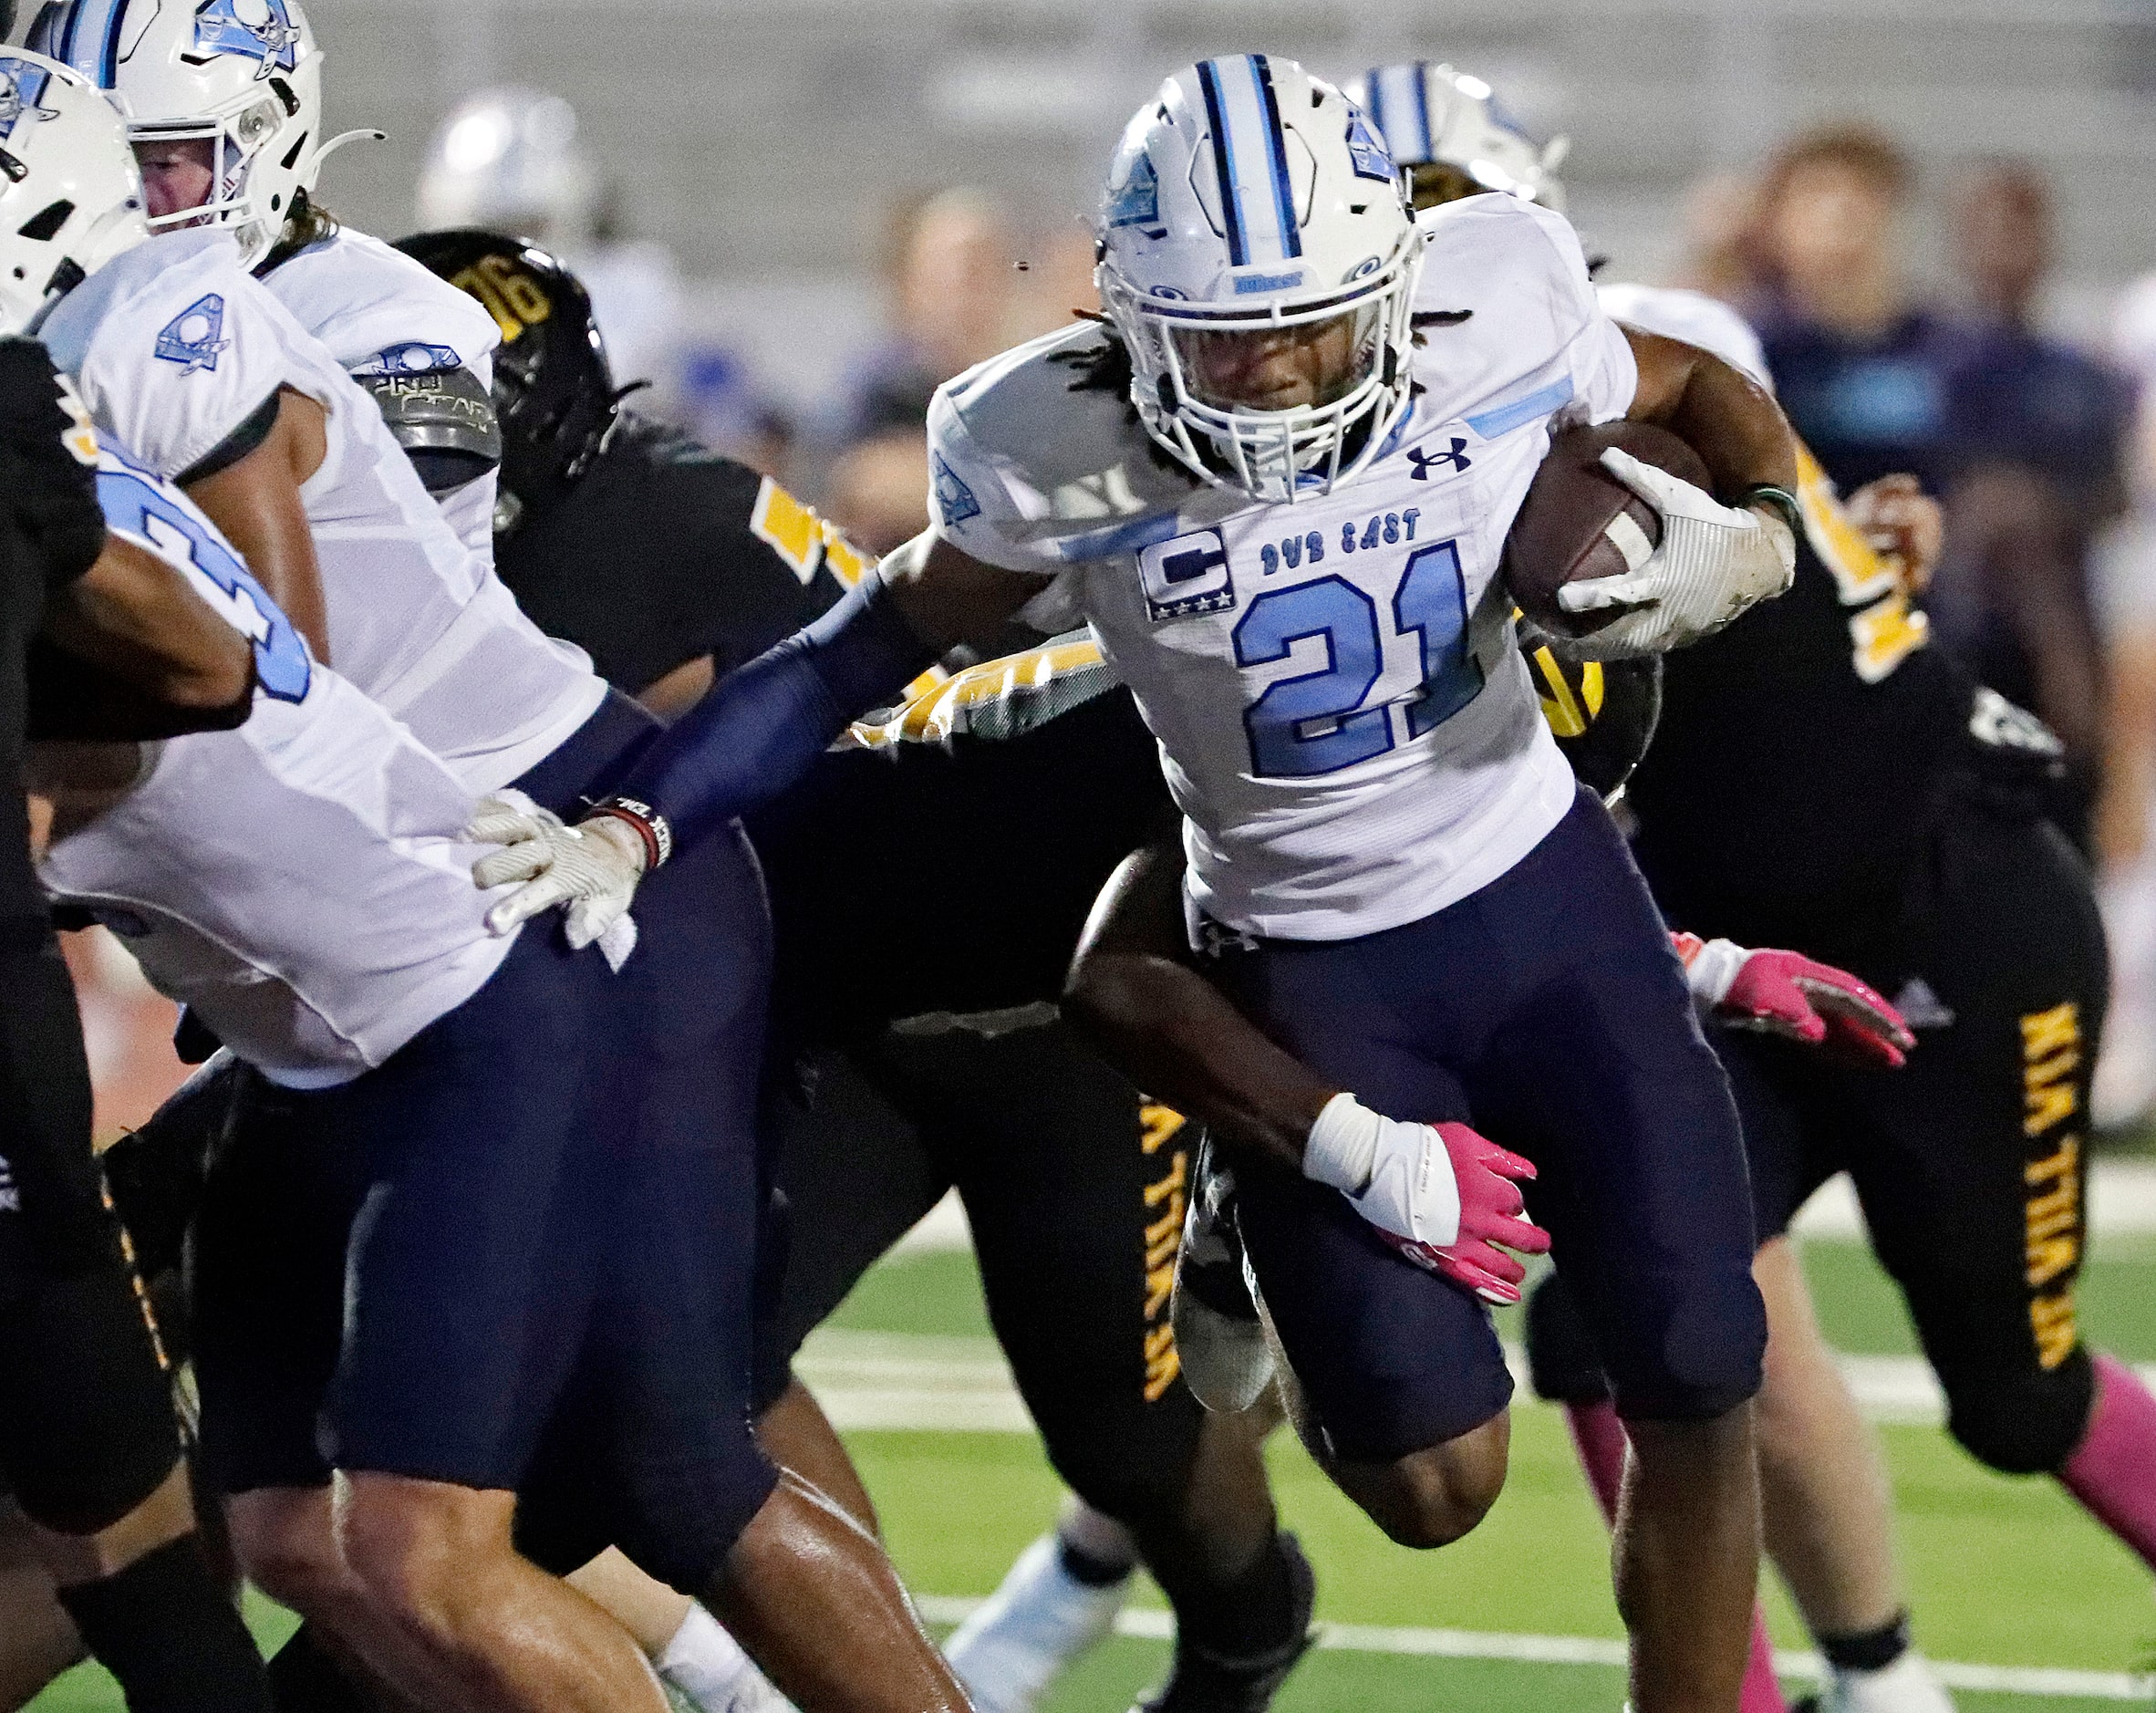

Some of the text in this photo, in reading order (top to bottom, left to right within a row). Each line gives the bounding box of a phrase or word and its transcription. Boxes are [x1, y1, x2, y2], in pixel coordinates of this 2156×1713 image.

[1140, 530, 1228, 605] C
[1260, 508, 1421, 576] DUB EAST
[1230, 540, 1486, 777] 21
